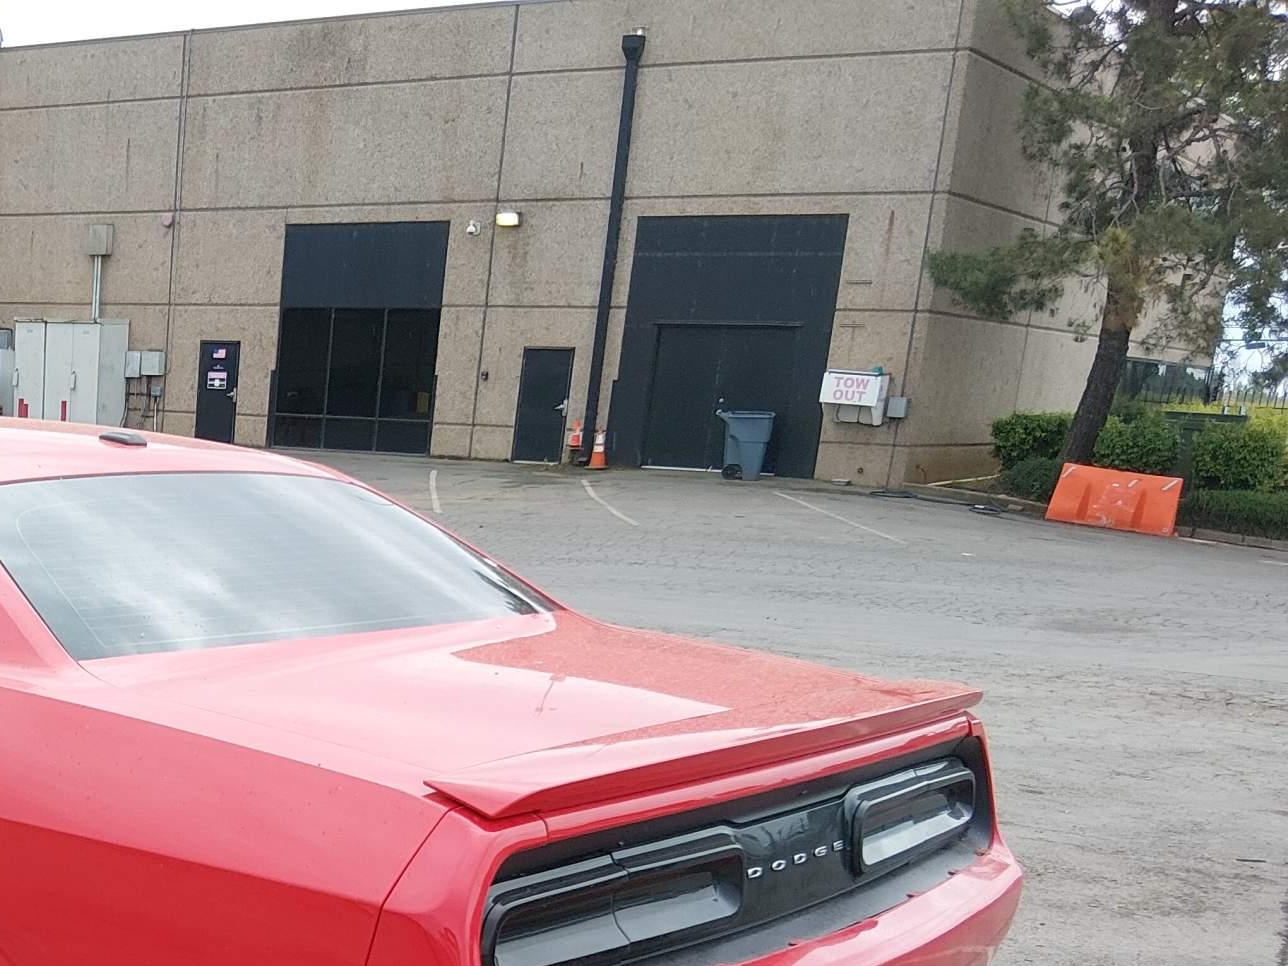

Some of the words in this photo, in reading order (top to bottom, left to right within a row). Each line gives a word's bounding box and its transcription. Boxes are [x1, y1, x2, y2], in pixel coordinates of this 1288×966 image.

[834, 376, 870, 390] TOW
[833, 389, 867, 402] OUT
[746, 840, 845, 879] DODGE
